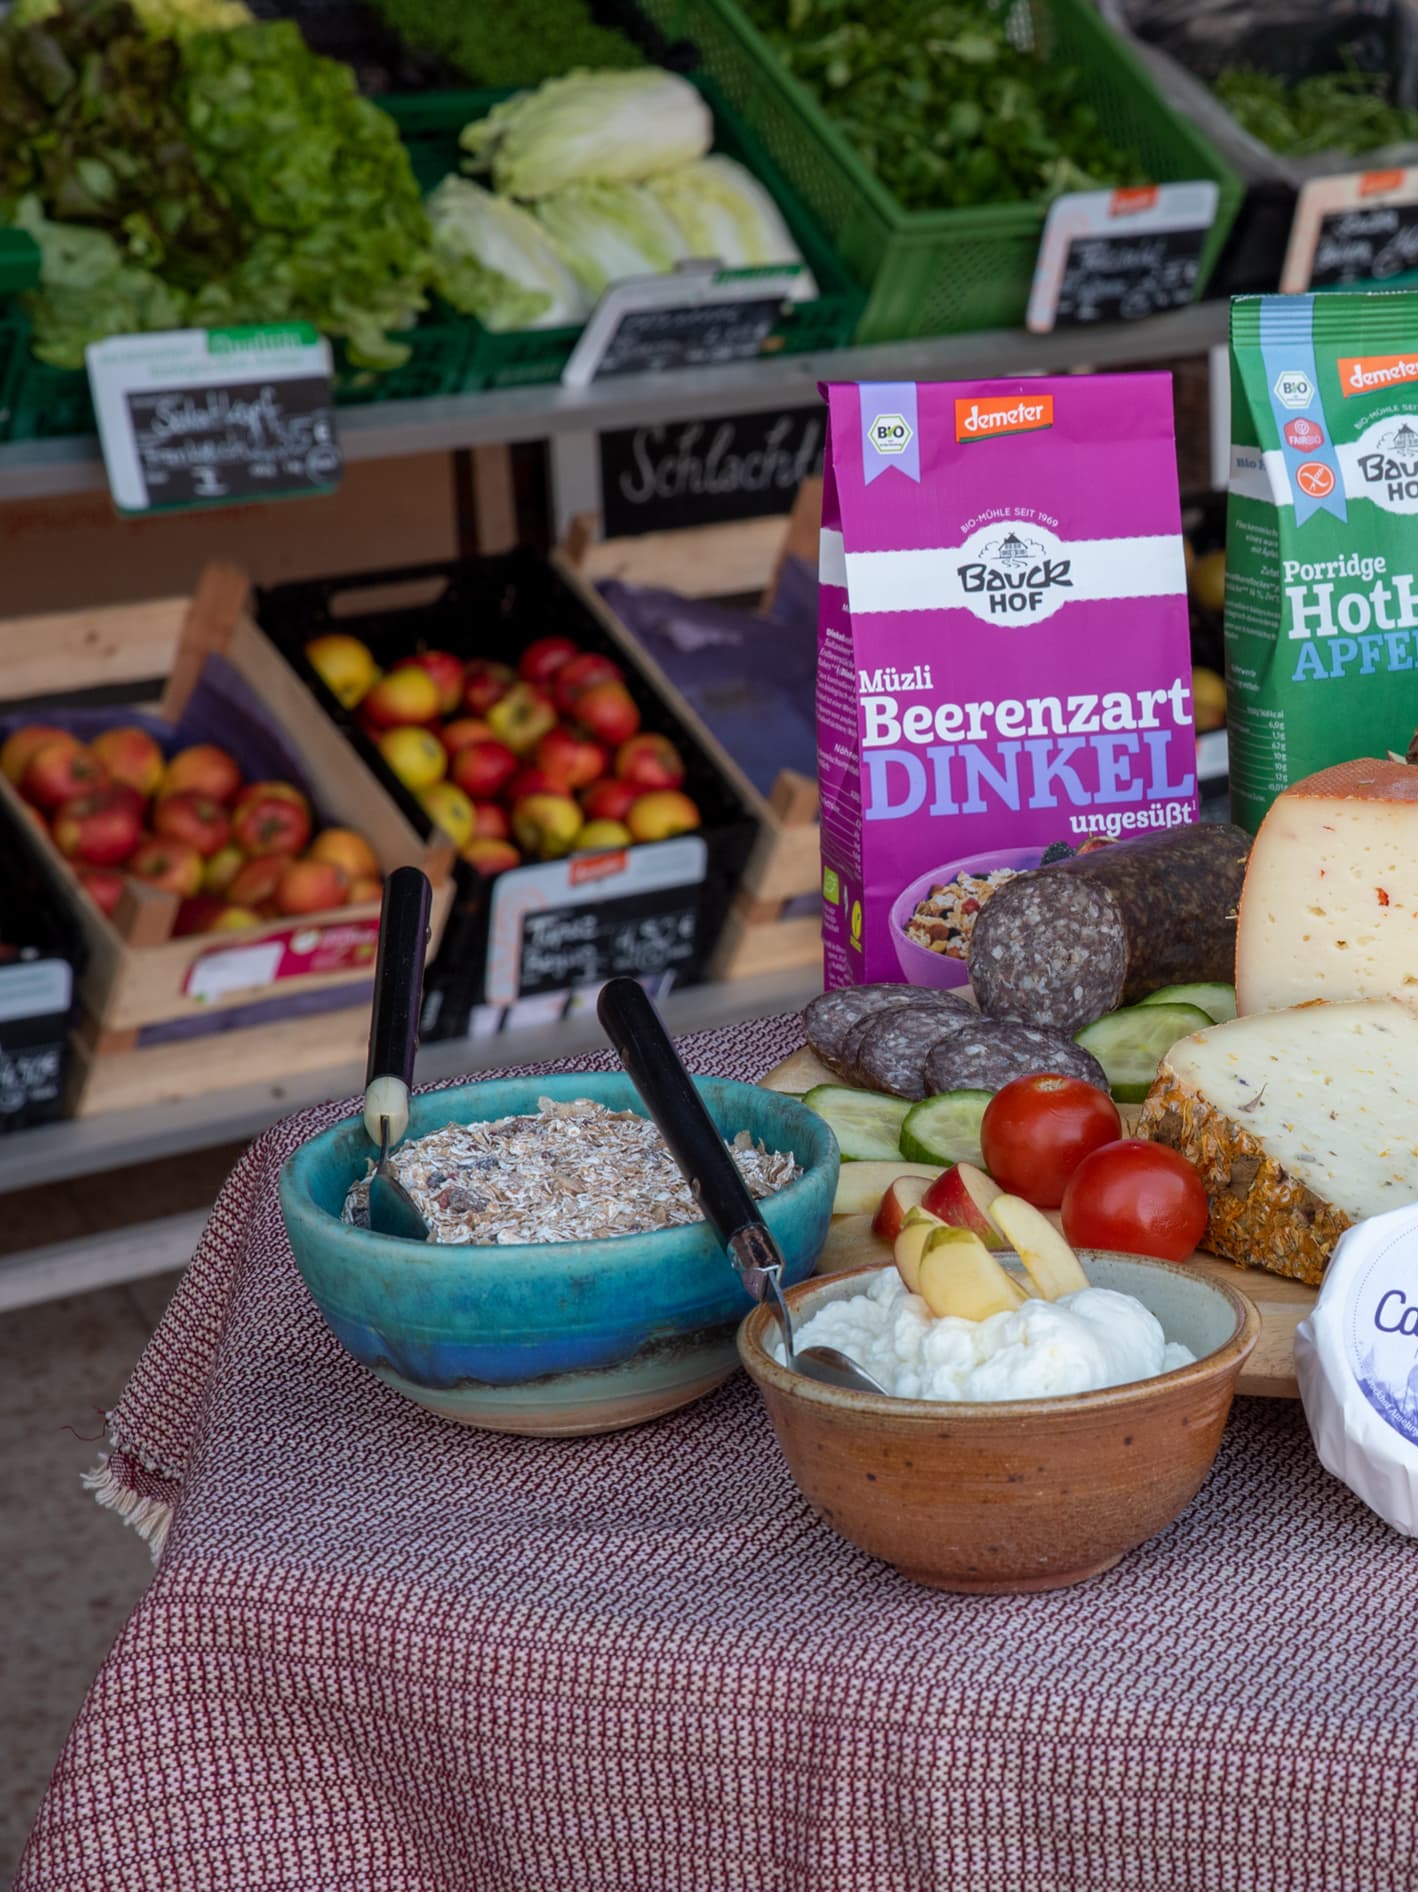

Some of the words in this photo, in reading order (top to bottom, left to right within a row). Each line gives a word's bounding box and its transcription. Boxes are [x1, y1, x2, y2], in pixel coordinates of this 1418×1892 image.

[1283, 381, 1308, 395] BIO
[963, 402, 1044, 432] demeter
[960, 507, 1011, 534] BIO-MÜHLE
[1013, 506, 1036, 518] SEIT
[1037, 513, 1059, 529] 1969
[1283, 553, 1386, 583] Porridge
[989, 592, 1043, 614] HOF
[858, 666, 933, 694] Müzli
[860, 677, 1193, 747] Beerenzart
[862, 730, 1195, 821] DINKEL
